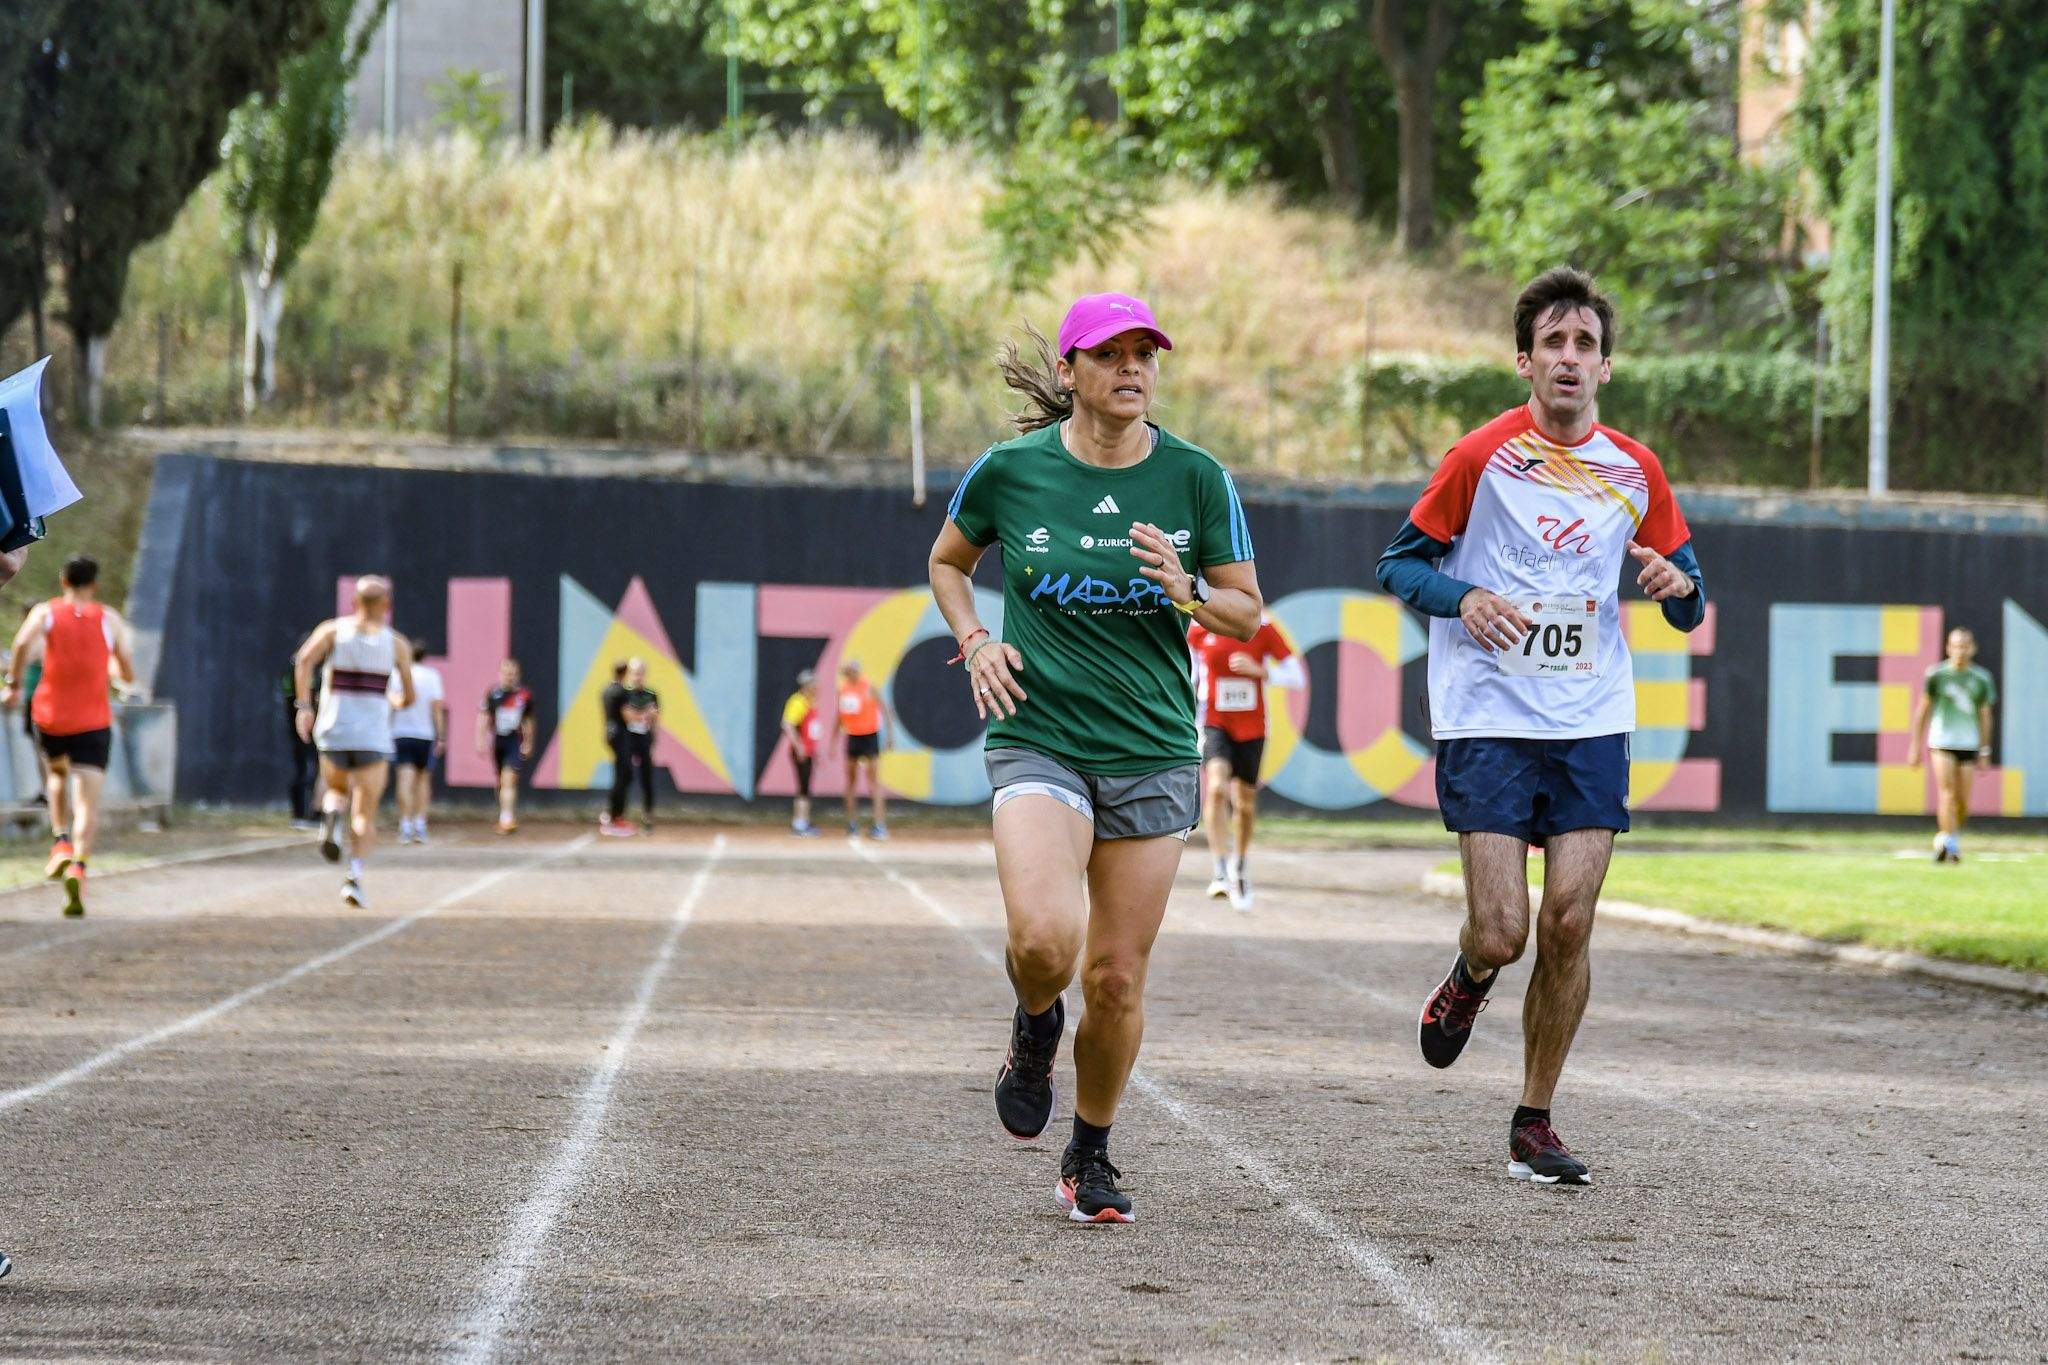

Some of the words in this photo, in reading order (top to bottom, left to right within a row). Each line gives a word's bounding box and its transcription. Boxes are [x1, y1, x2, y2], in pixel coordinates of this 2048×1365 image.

[1097, 538, 1133, 547] ZURICH
[1523, 624, 1583, 657] 705
[1575, 662, 1593, 670] 2023
